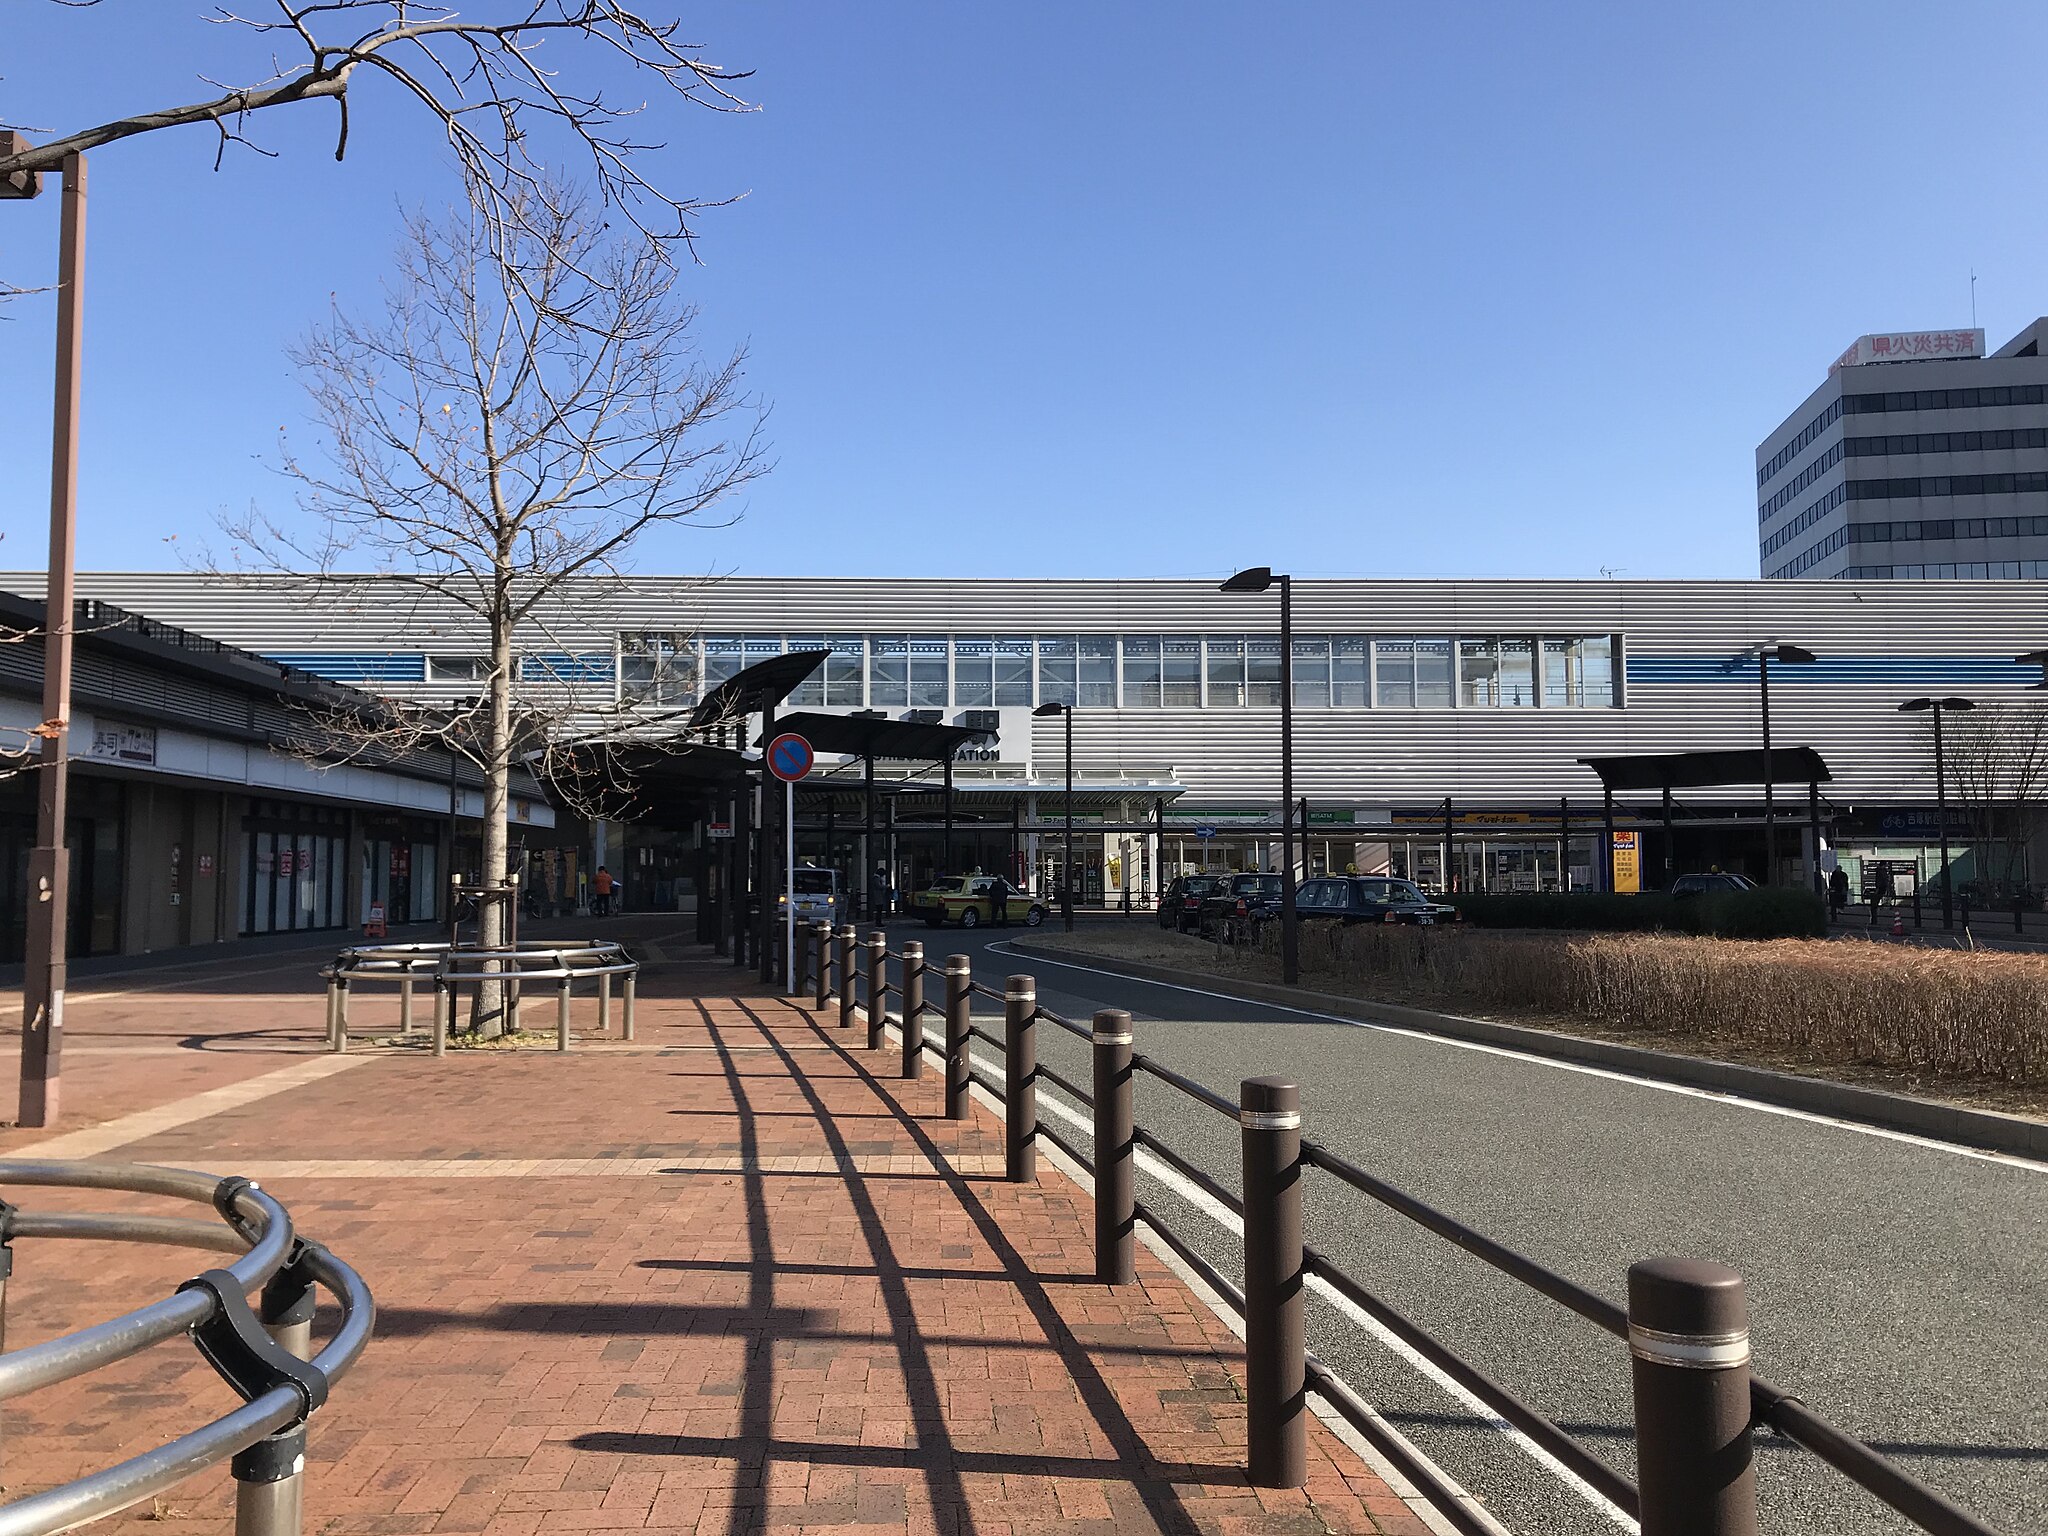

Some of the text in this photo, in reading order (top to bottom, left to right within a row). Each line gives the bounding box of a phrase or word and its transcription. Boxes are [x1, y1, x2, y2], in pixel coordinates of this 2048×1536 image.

[1872, 333, 1974, 356] 県火災共済
[948, 749, 1000, 761] TATION
[1045, 853, 1056, 902] FamilyMart
